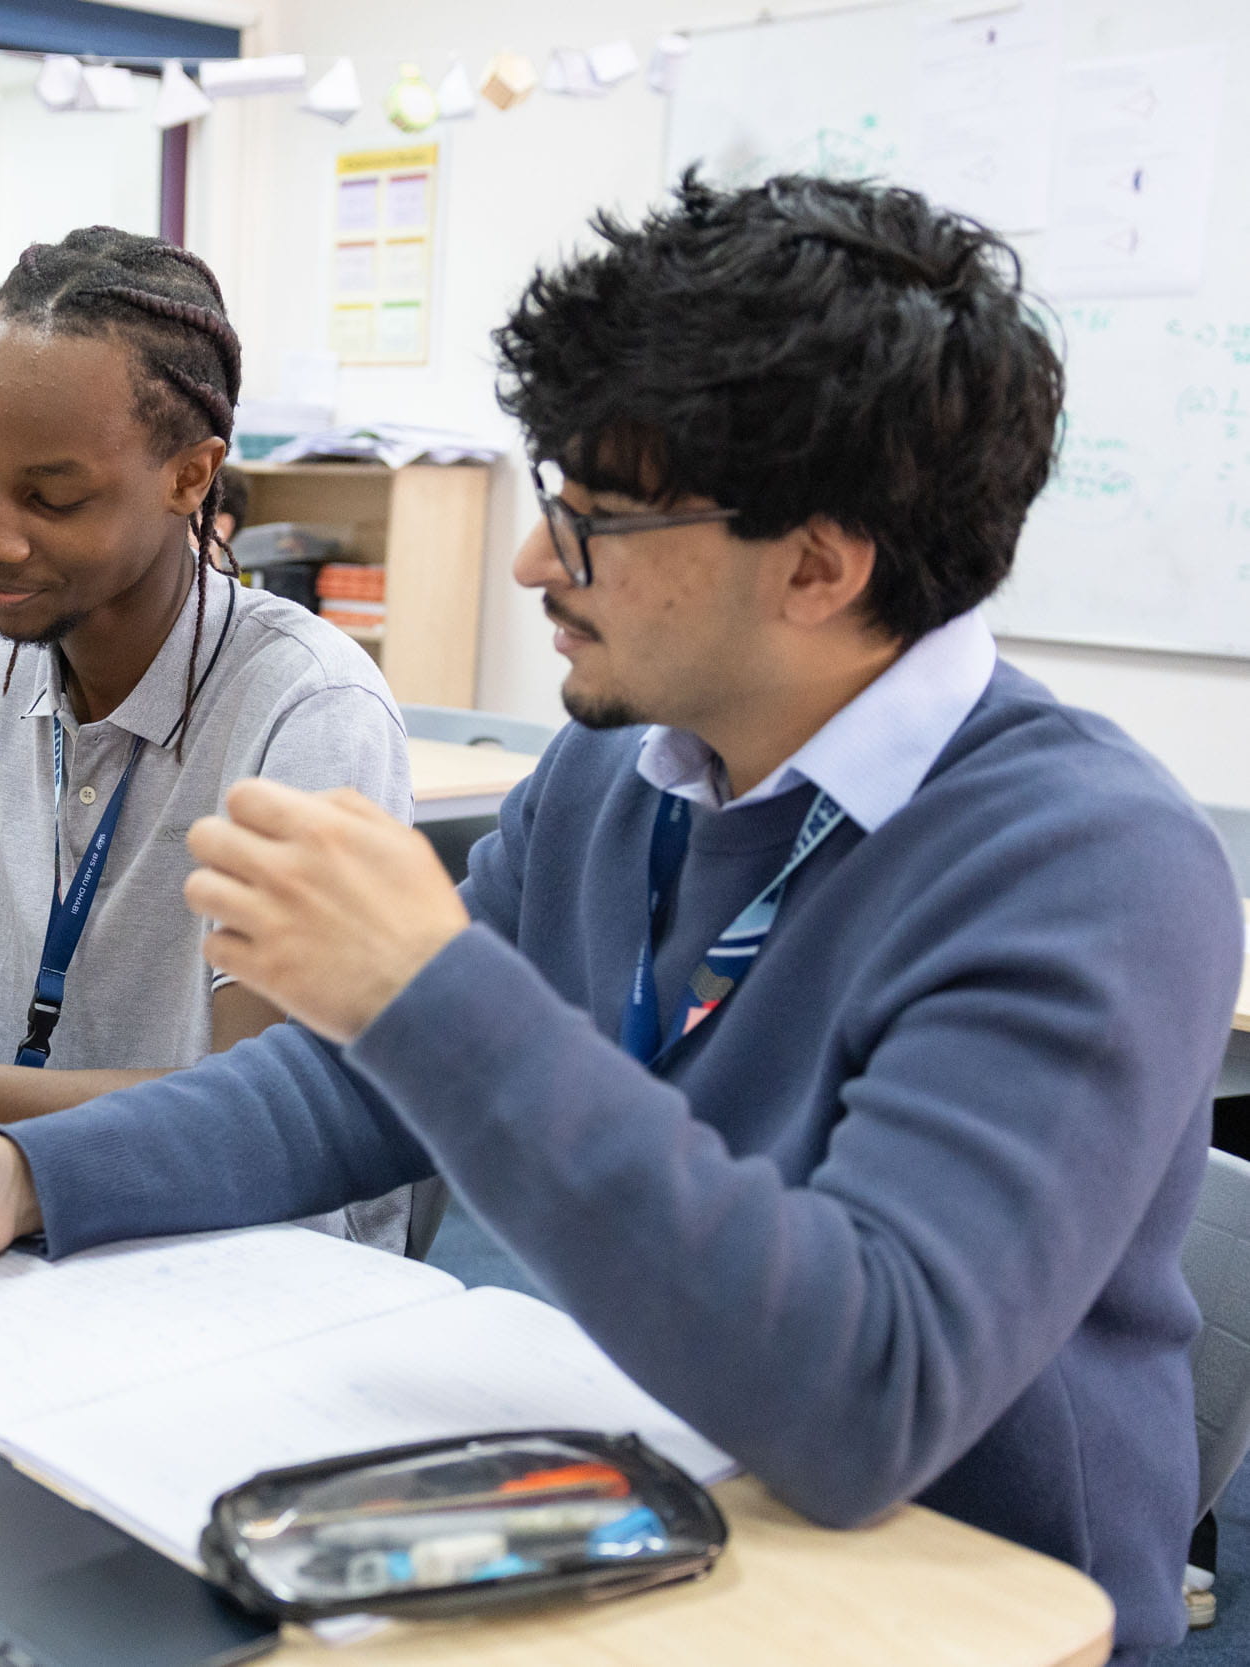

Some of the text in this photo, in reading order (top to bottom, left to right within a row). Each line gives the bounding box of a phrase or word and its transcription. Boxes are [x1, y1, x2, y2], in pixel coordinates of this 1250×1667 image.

[70, 852, 99, 915] BIS ABU DHABI
